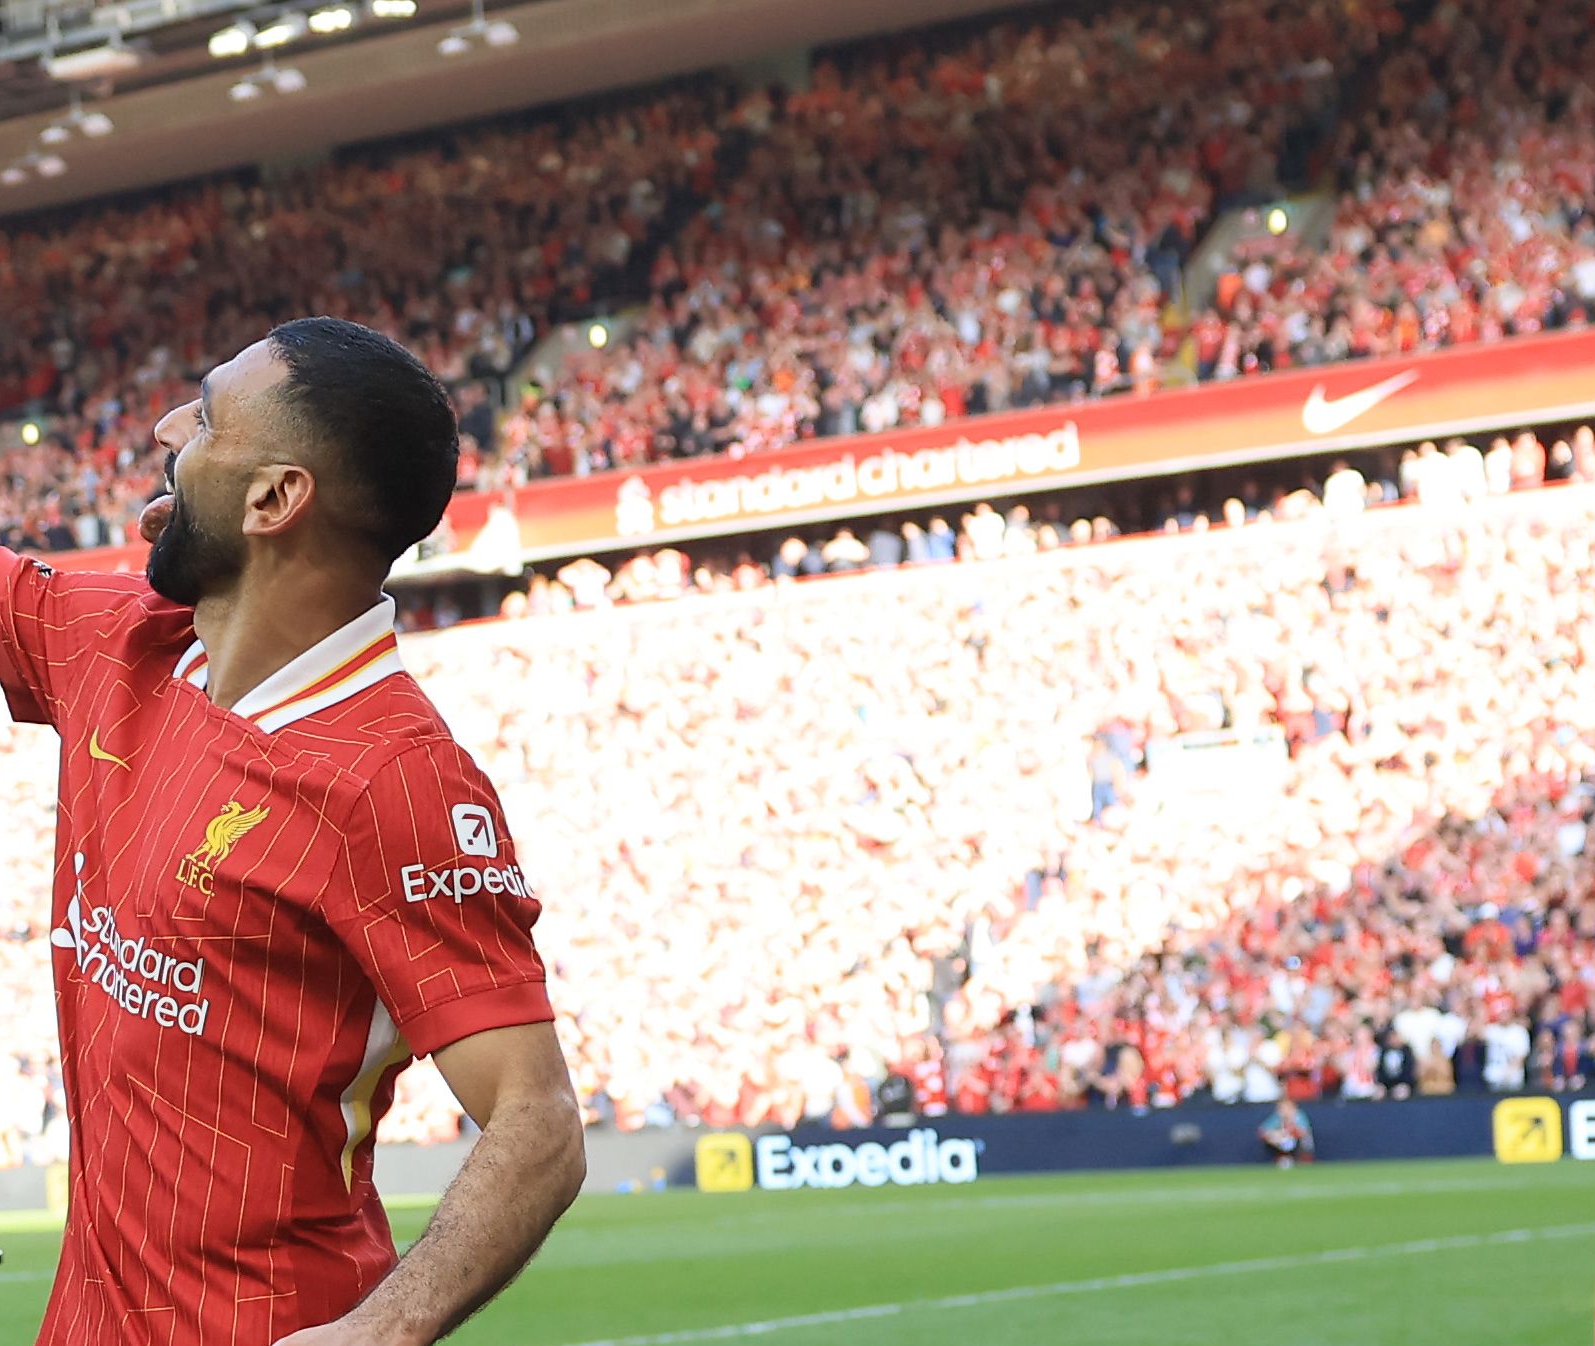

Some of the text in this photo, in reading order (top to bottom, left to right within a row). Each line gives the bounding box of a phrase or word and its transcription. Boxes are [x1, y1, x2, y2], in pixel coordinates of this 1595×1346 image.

[659, 420, 1081, 526] standard chartered
[756, 1127, 980, 1190] Expedia
